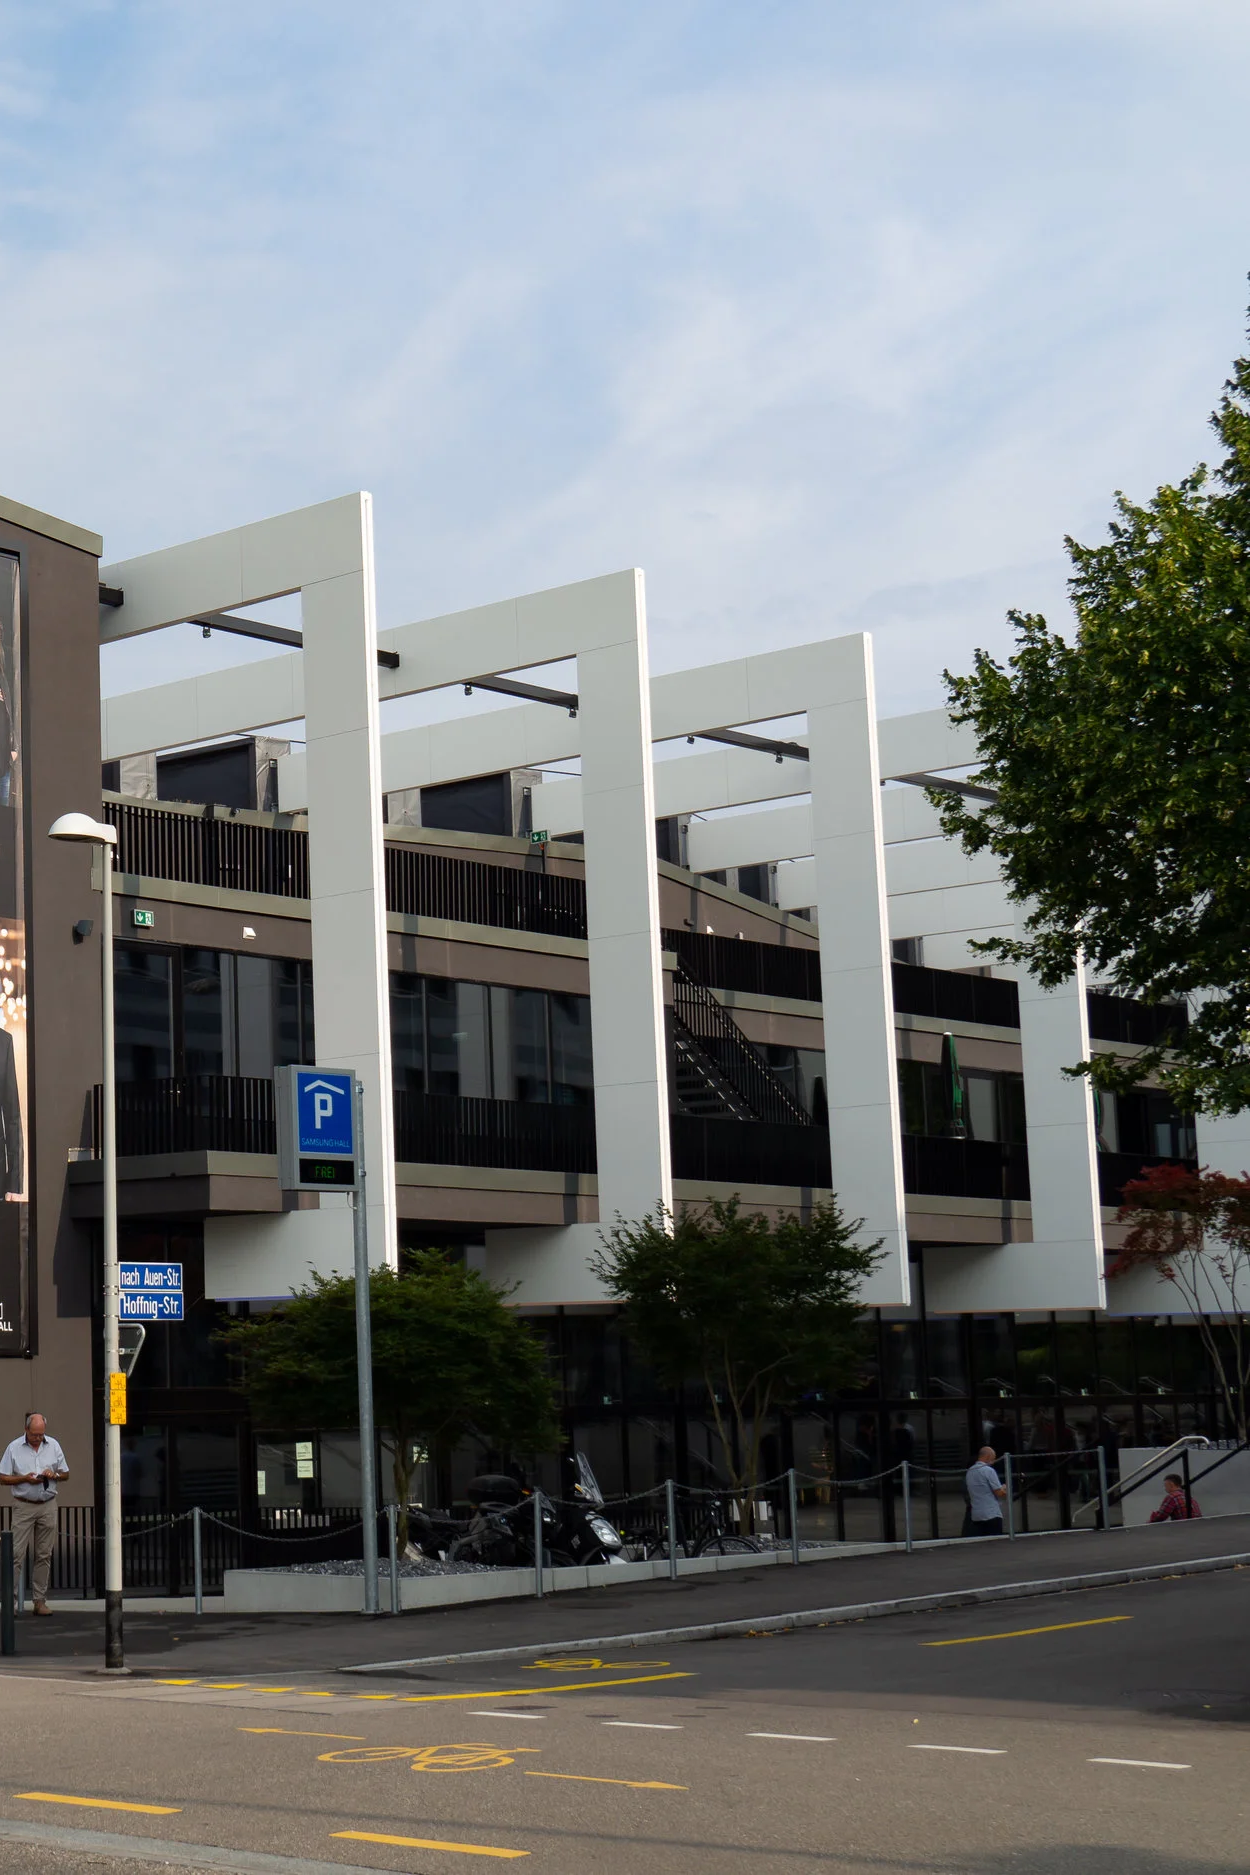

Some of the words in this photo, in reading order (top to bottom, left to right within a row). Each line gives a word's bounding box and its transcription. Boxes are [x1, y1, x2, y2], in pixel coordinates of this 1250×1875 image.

[301, 1137, 334, 1147] SAMSUNG
[335, 1139, 351, 1148] HALL
[314, 1165, 336, 1179] FREI
[121, 1267, 140, 1286] nach
[144, 1267, 180, 1286] Auen-Str.
[123, 1295, 180, 1319] Hoffnig-Str.
